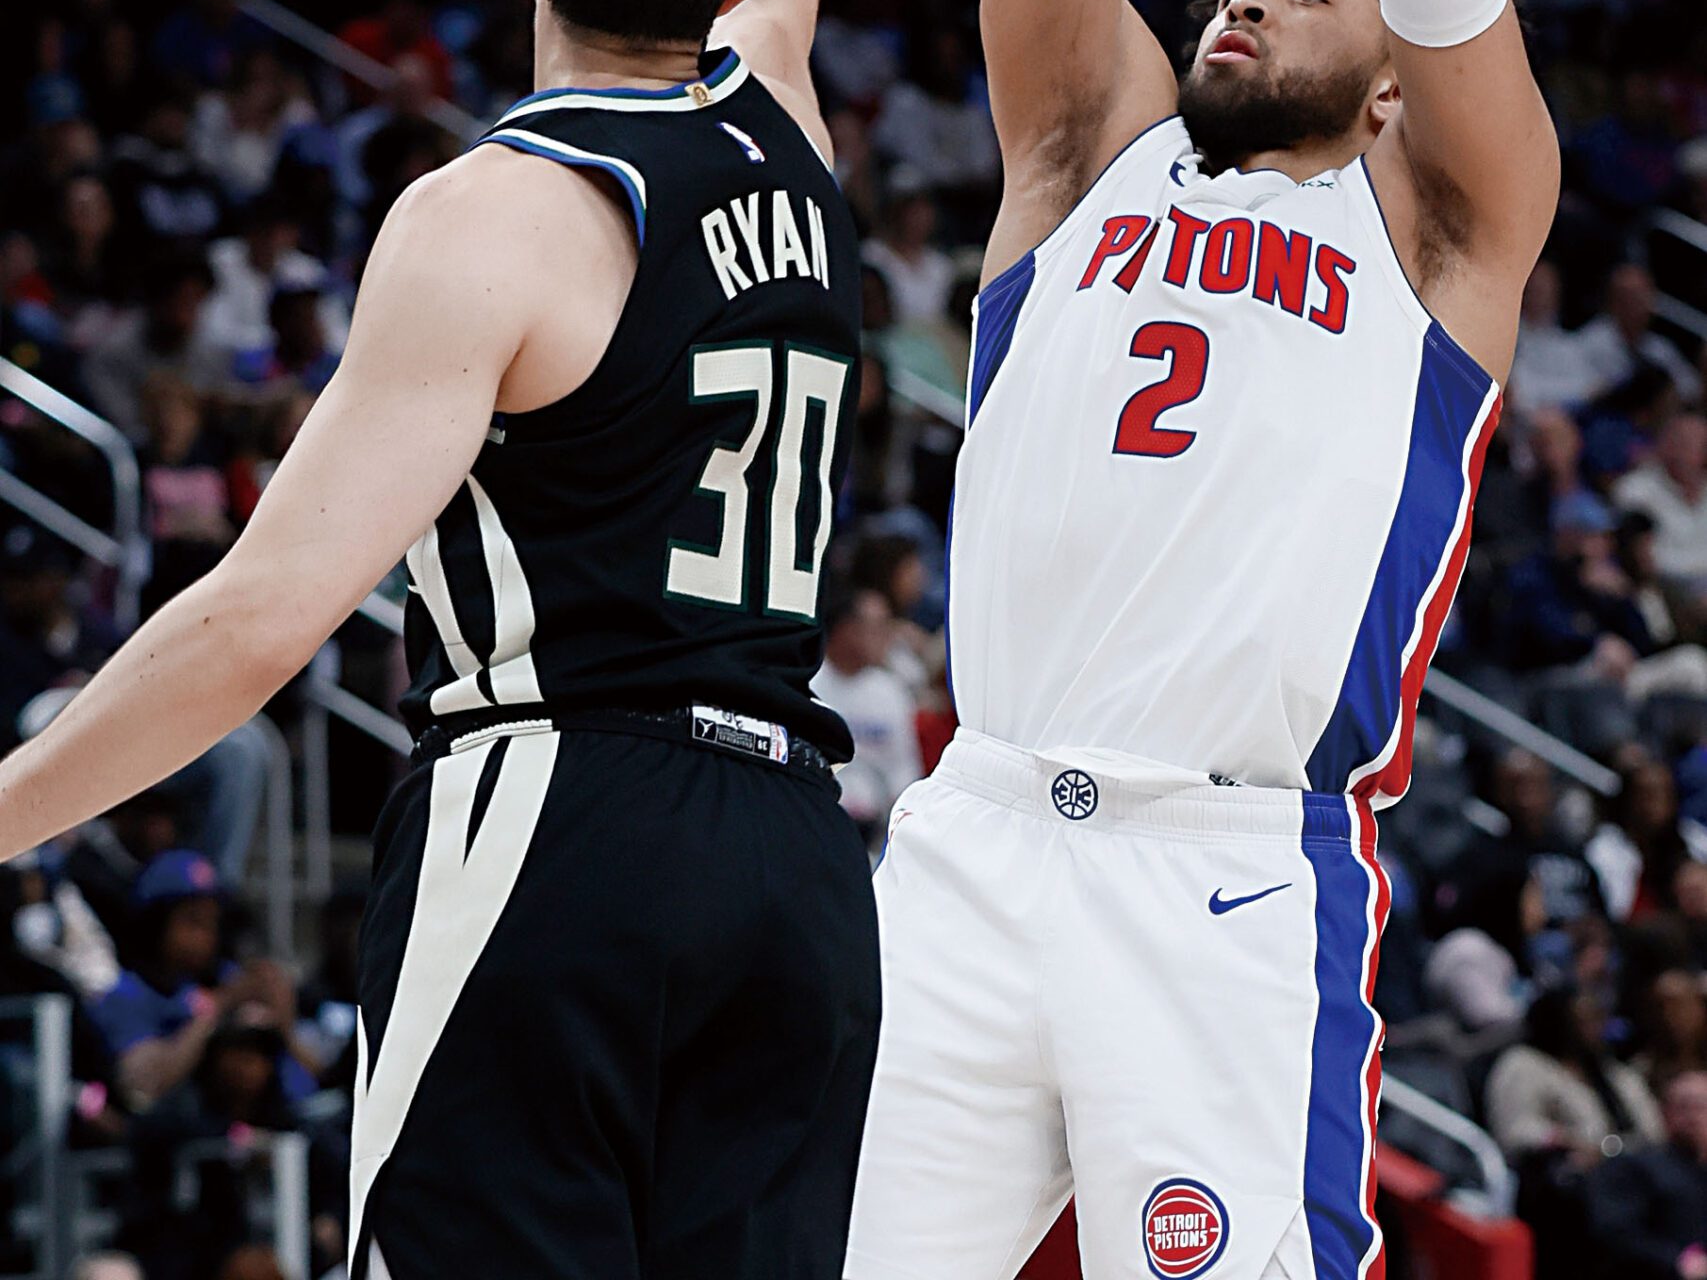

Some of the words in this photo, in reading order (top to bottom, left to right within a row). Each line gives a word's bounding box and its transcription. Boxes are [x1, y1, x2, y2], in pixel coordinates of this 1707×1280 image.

[701, 190, 829, 301] RYAN
[1112, 321, 1210, 458] 2
[664, 340, 853, 623] 30
[1153, 1213, 1208, 1233] DETROIT
[1153, 1230, 1208, 1251] PISTONS
